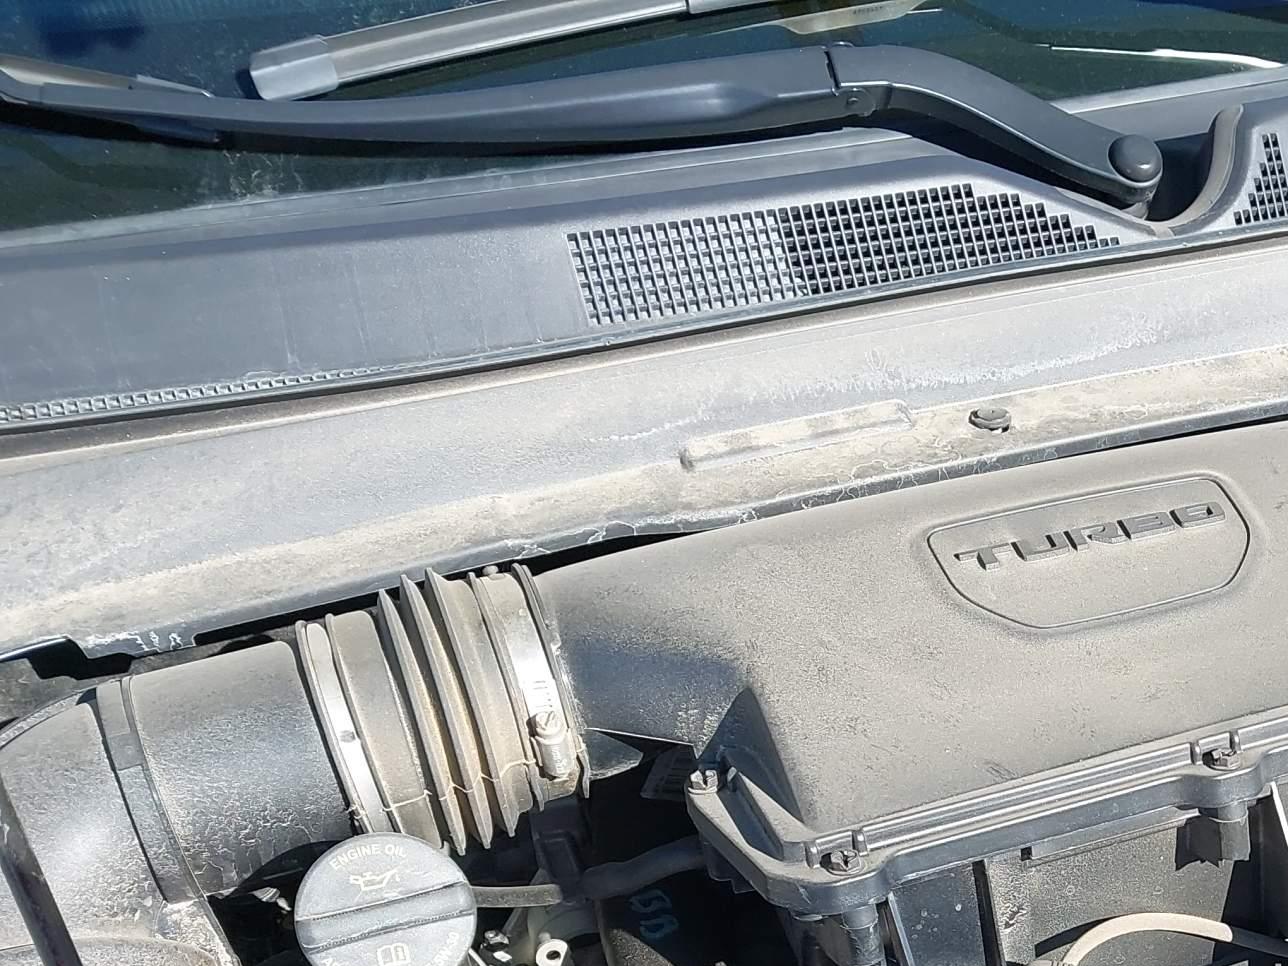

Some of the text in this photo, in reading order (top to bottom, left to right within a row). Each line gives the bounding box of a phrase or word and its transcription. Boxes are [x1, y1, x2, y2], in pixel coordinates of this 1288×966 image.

[953, 501, 1227, 571] TURBO
[329, 843, 408, 871] ENGINE OIL
